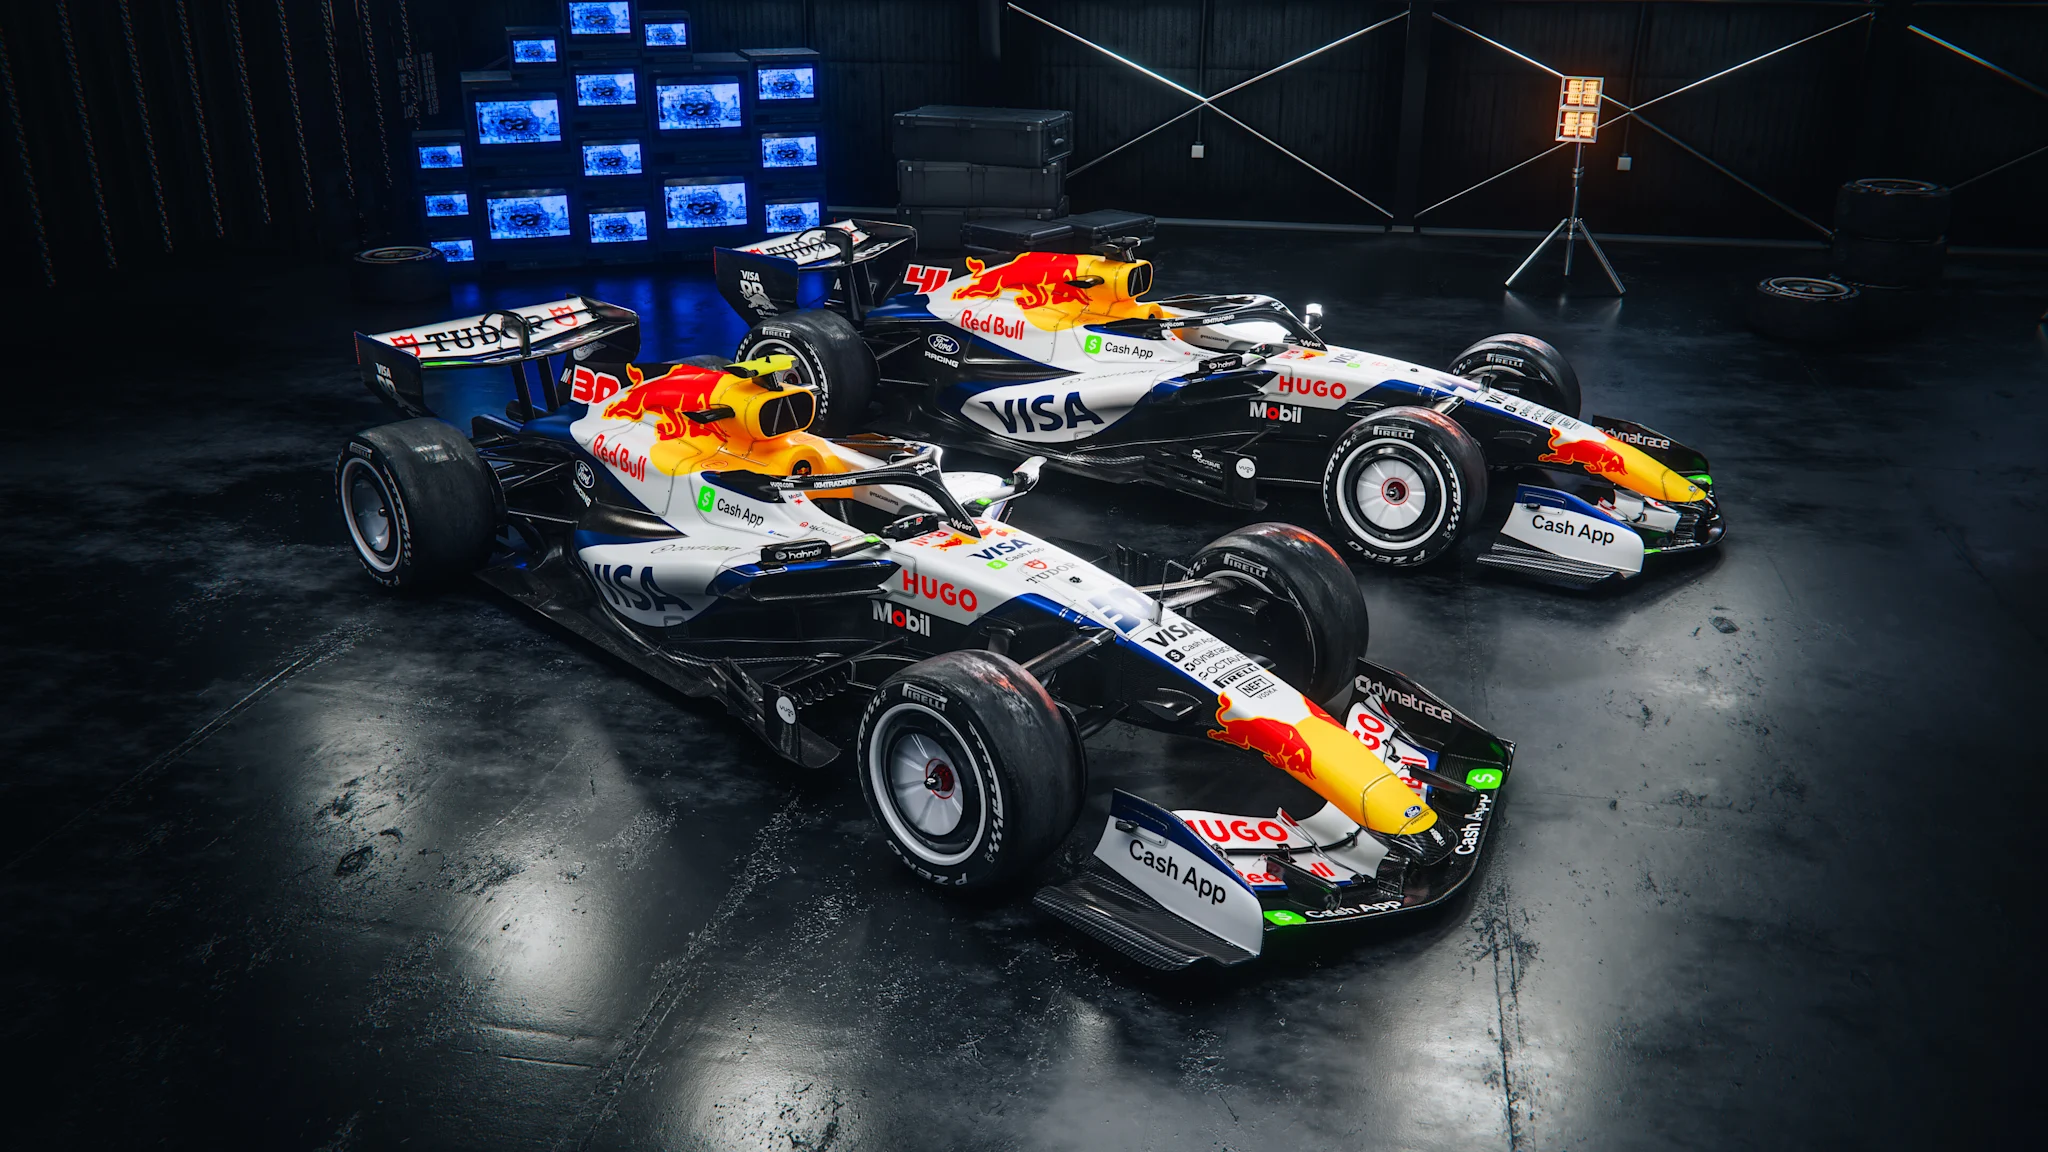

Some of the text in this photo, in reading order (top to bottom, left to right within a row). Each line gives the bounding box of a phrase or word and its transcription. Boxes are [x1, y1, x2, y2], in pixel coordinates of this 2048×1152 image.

[740, 270, 760, 281] VISA
[762, 327, 791, 338] PIRELLI
[961, 309, 1025, 340] Red Bull
[931, 337, 957, 352] Ford
[1105, 341, 1130, 355] Cash
[1131, 345, 1154, 360] App
[924, 351, 960, 368] RACING
[1278, 375, 1347, 399] HUGO
[979, 391, 1105, 434] VISA
[1250, 401, 1302, 424] Mobil
[1373, 426, 1415, 440] PIRELLI
[594, 434, 647, 482] Red Bull
[717, 498, 741, 519] Cash
[742, 507, 764, 528] App
[1532, 514, 1615, 546] Cash App
[966, 538, 1032, 561] VISA
[1026, 562, 1078, 584] TUDOR
[1223, 553, 1268, 579] PIRELLI
[902, 569, 978, 612] HUGO
[872, 600, 931, 637] Mobil
[1141, 622, 1202, 648] VISA
[1181, 639, 1203, 652] Cash
[1193, 645, 1234, 666] dynatrace
[1206, 653, 1248, 675] OCTAVE
[1212, 663, 1260, 689] PIRELLI
[1241, 678, 1268, 694] NEFT
[902, 682, 948, 712] PIRELLI
[1257, 688, 1278, 700] VODKA
[1371, 681, 1453, 724] dynatrace
[1455, 793, 1492, 856] Cash App
[1129, 839, 1226, 906] Cash App
[1304, 906, 1360, 919] Cash
[1359, 900, 1402, 912] App
